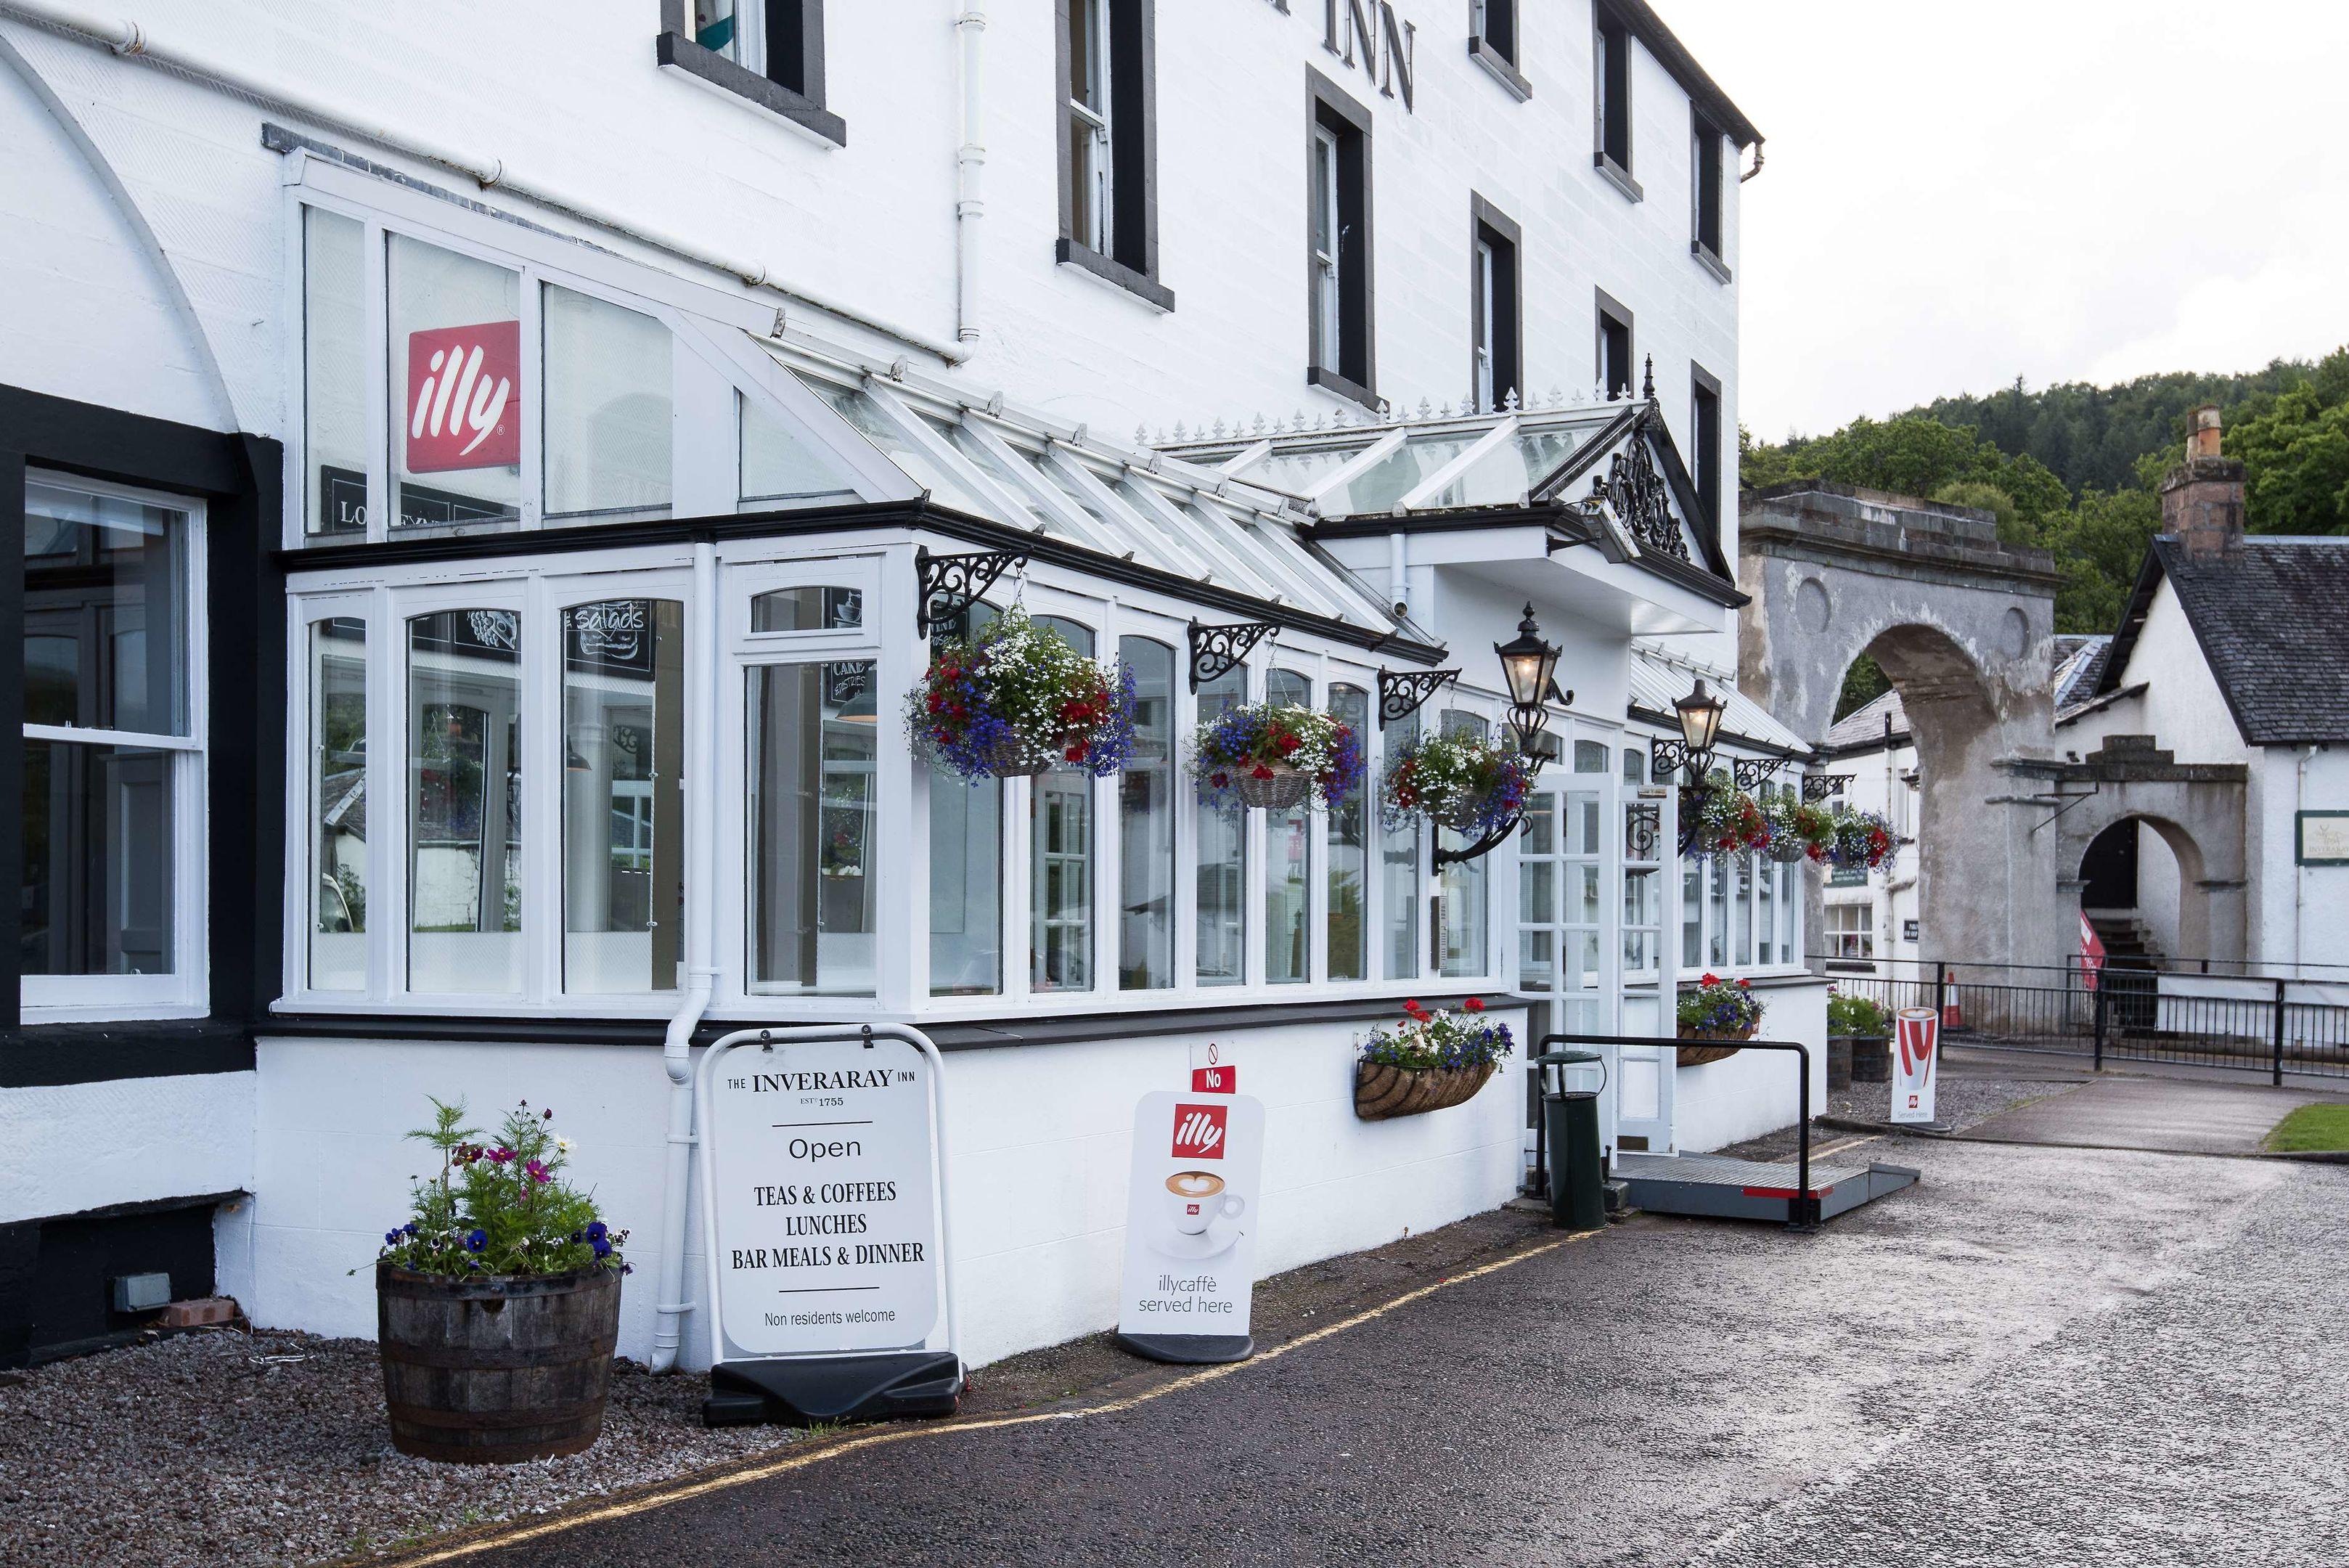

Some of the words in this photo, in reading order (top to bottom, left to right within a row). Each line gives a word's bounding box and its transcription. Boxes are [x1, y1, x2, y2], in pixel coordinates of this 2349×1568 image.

[1324, 0, 1416, 115] INN
[412, 344, 510, 457] illy
[727, 1078, 746, 1090] THE
[752, 1069, 894, 1093] INVERARAY
[898, 1071, 915, 1082] INN
[1206, 1069, 1222, 1088] No
[819, 1097, 843, 1106] 1755
[1176, 1112, 1223, 1154] illy
[789, 1138, 861, 1163] Open
[753, 1185, 797, 1206] TEAS
[803, 1186, 815, 1204] &
[821, 1181, 896, 1204] COFFEES
[785, 1214, 867, 1236] LUNCHES
[732, 1249, 768, 1270] BAR
[772, 1246, 832, 1267] MEALS
[837, 1246, 850, 1265] &
[855, 1242, 925, 1265] DINNER
[1159, 1275, 1217, 1296] illycaffè
[1138, 1297, 1192, 1312] served
[1198, 1297, 1233, 1313] here
[765, 1312, 787, 1326] Non
[791, 1310, 843, 1326] residents
[846, 1309, 896, 1323] welcome
